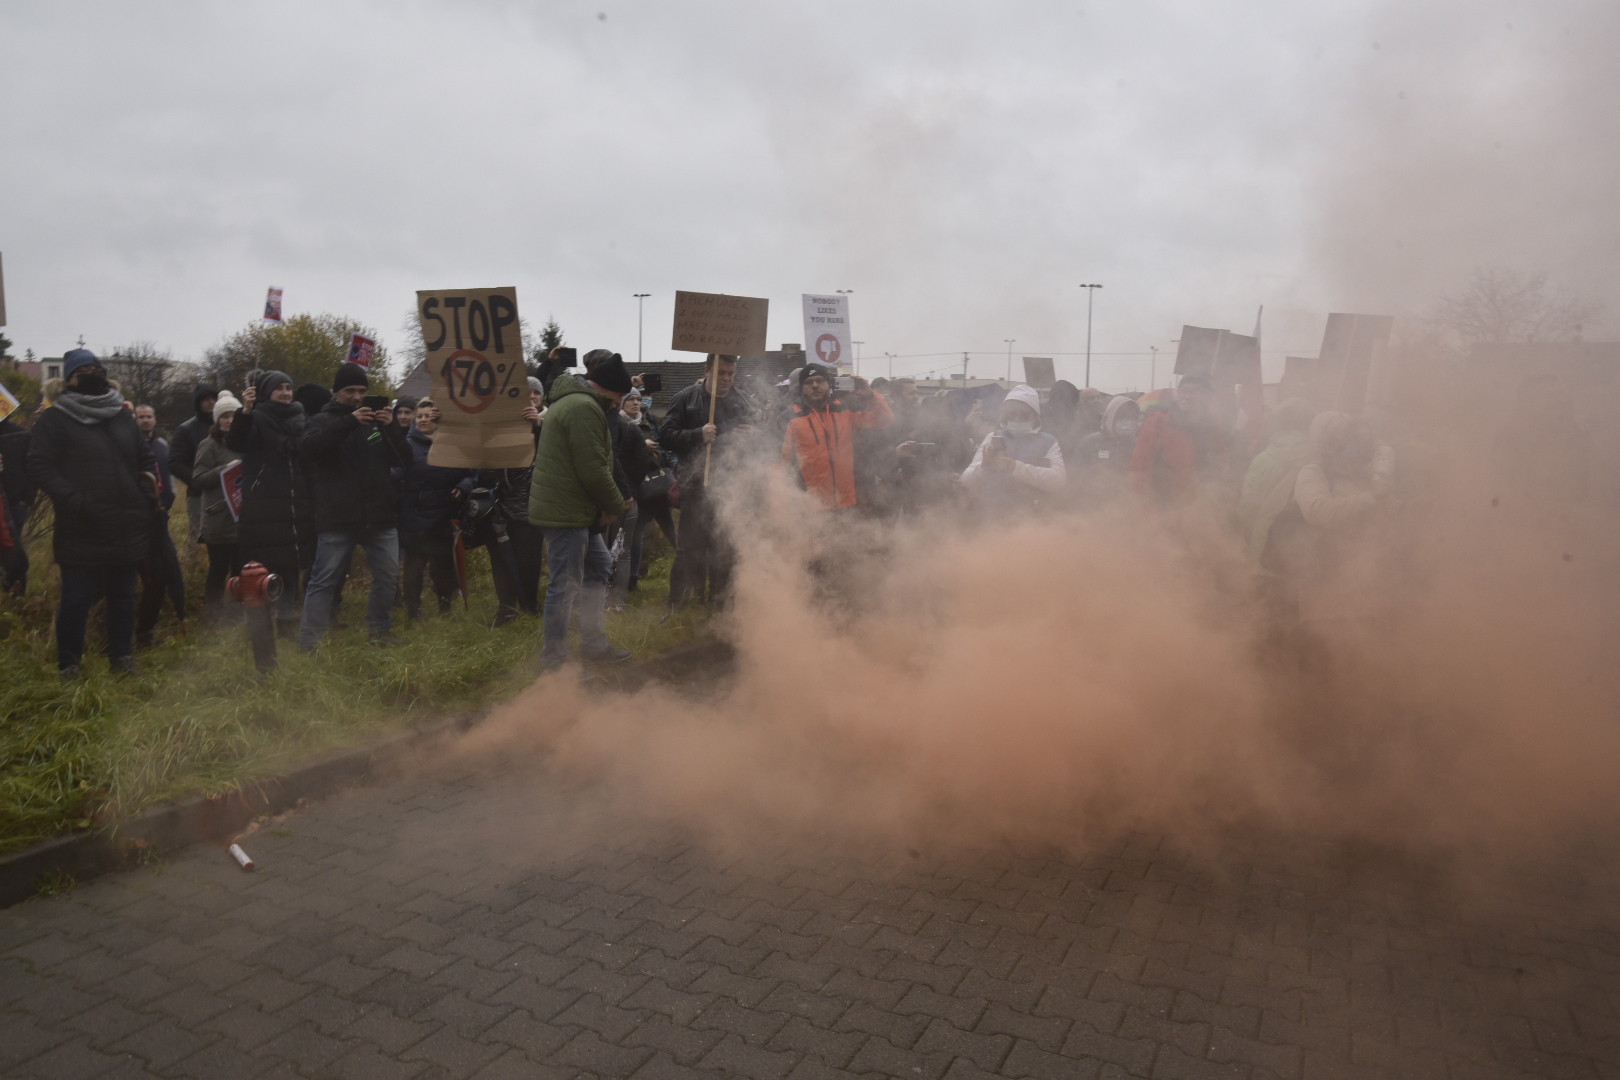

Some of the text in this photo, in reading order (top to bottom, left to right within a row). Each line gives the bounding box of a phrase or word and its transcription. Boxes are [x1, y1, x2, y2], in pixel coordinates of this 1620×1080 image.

[679, 294, 749, 309] RACHUNEK
[812, 297, 840, 305] NOBODY
[422, 295, 515, 354] STOP
[441, 357, 521, 399] 170%
